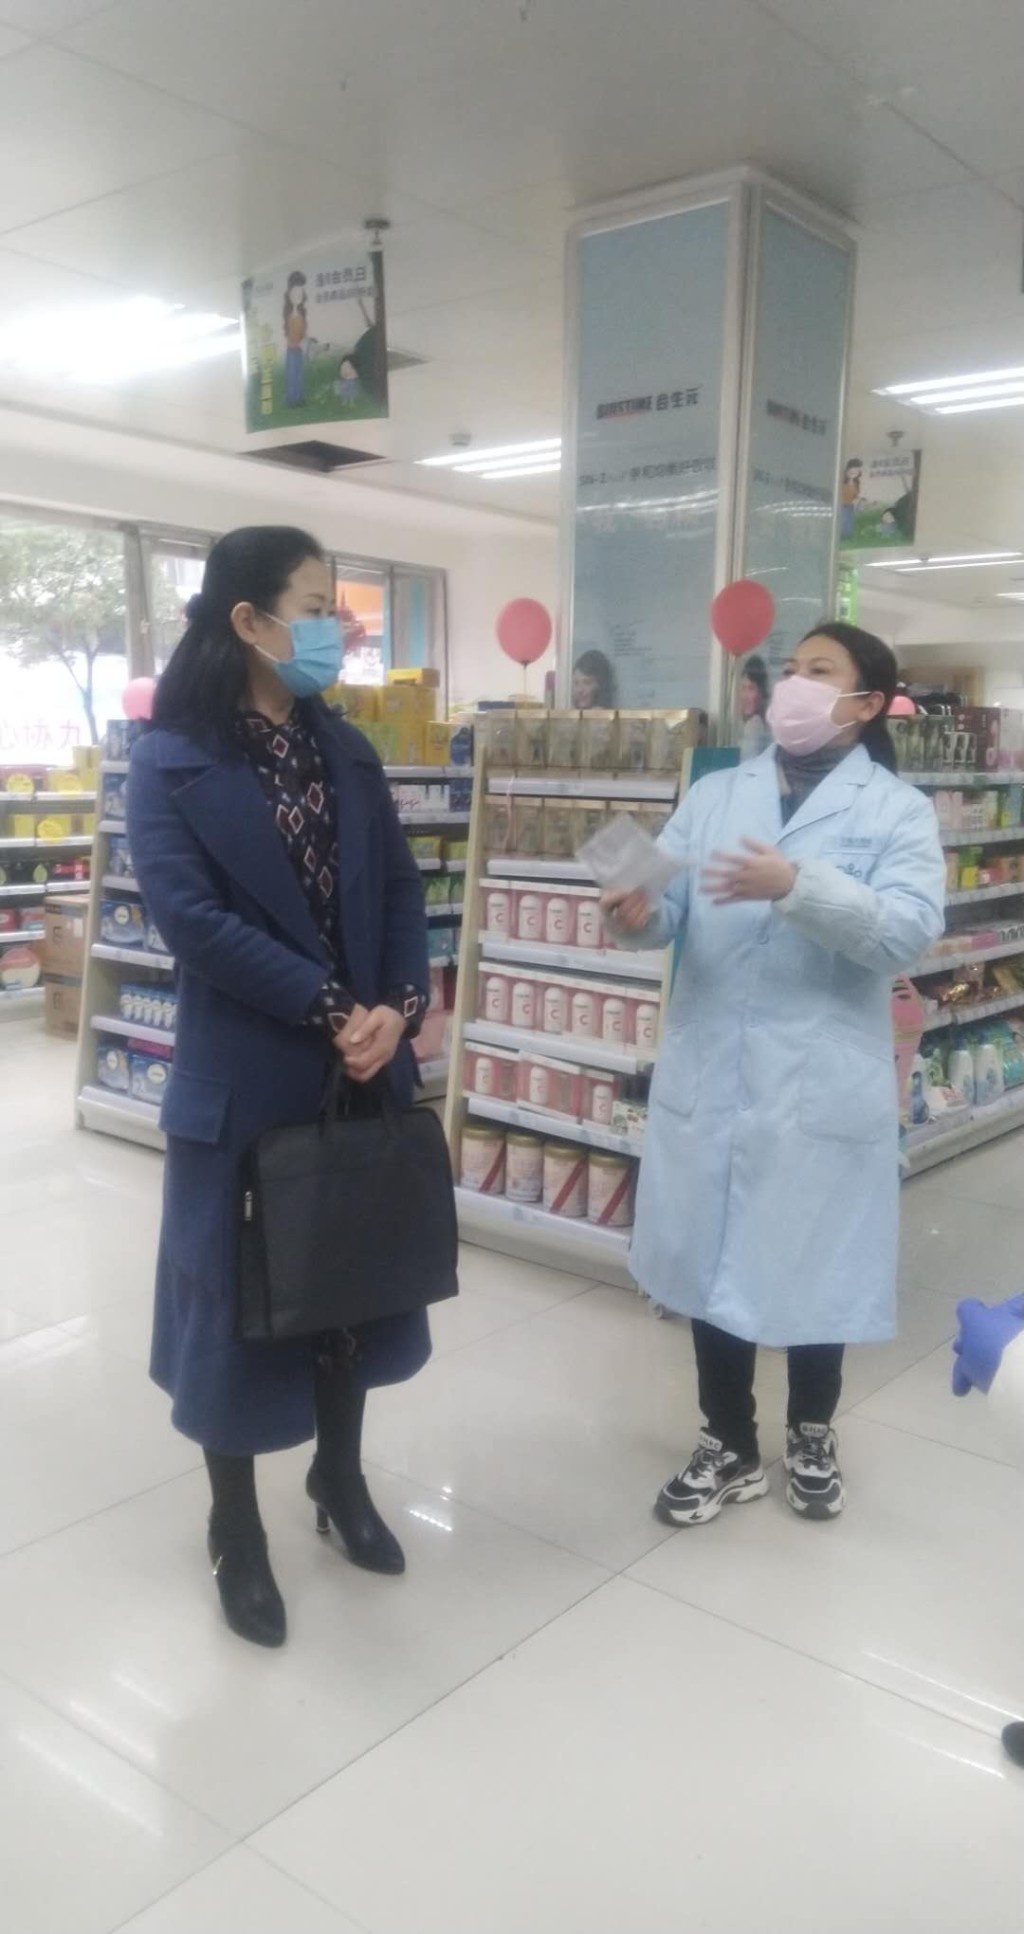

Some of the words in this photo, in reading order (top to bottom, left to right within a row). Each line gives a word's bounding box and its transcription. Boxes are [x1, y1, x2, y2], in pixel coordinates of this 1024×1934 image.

[656, 383, 704, 411] 合生元
[495, 912, 504, 923] C
[527, 916, 536, 926] C
[554, 919, 563, 930] C
[583, 922, 593, 933] C
